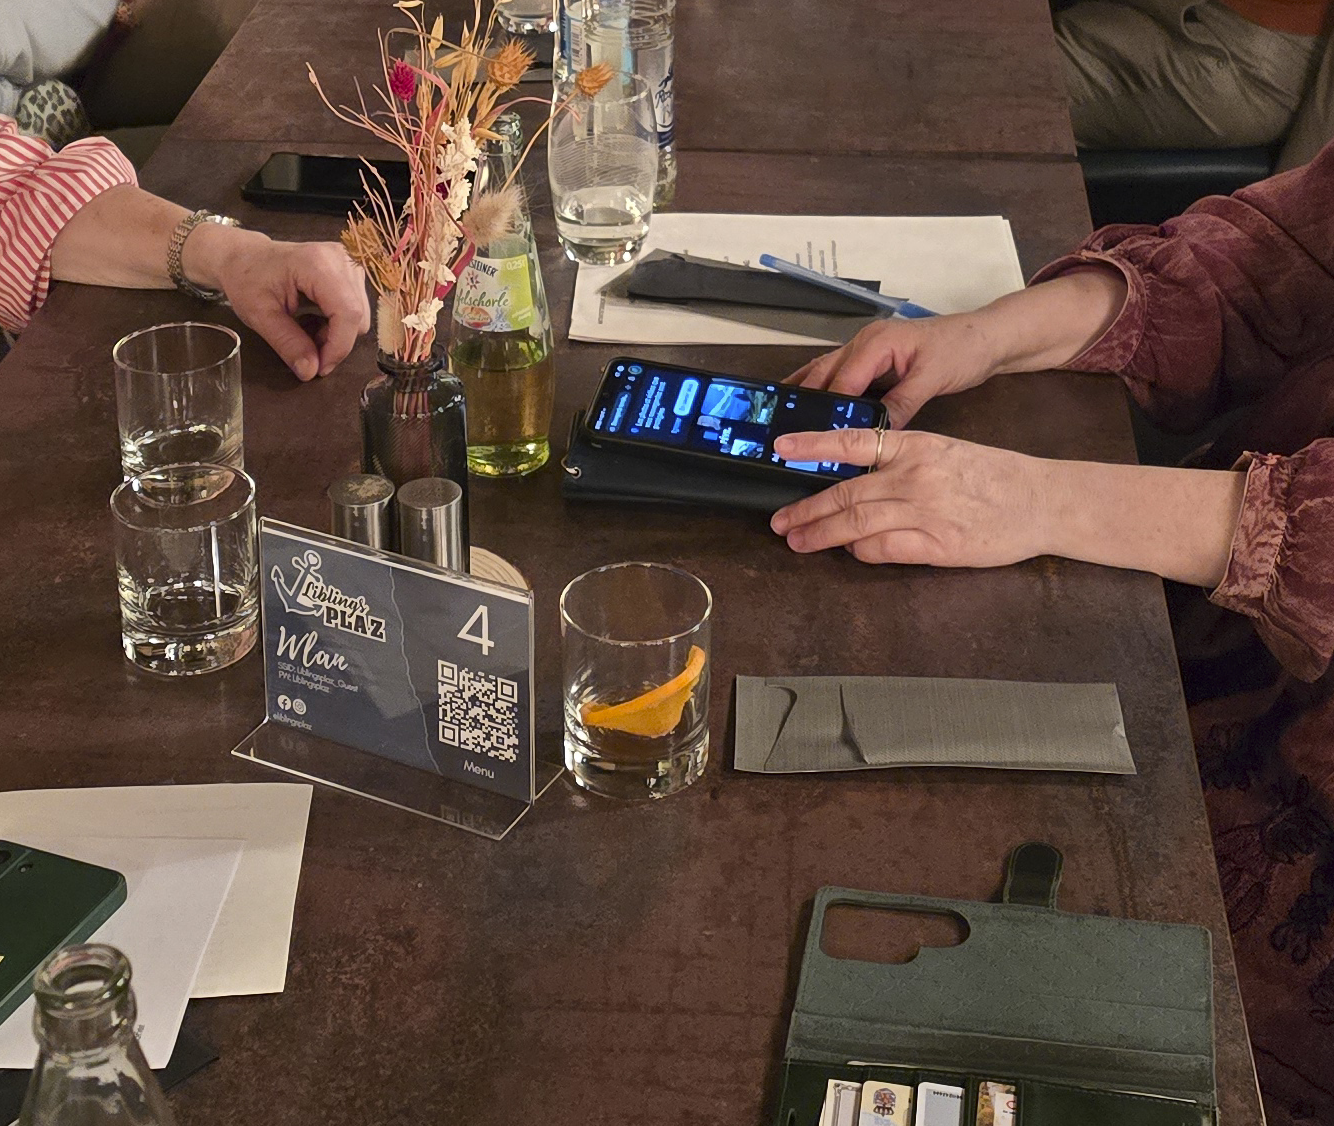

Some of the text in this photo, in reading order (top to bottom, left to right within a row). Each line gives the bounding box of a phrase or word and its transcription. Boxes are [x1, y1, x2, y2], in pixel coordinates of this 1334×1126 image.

[301, 581, 367, 618] Liblings
[325, 606, 384, 639] PLAZ
[457, 605, 495, 655] 4
[277, 626, 348, 670] Wlan
[463, 759, 495, 779] Menu
